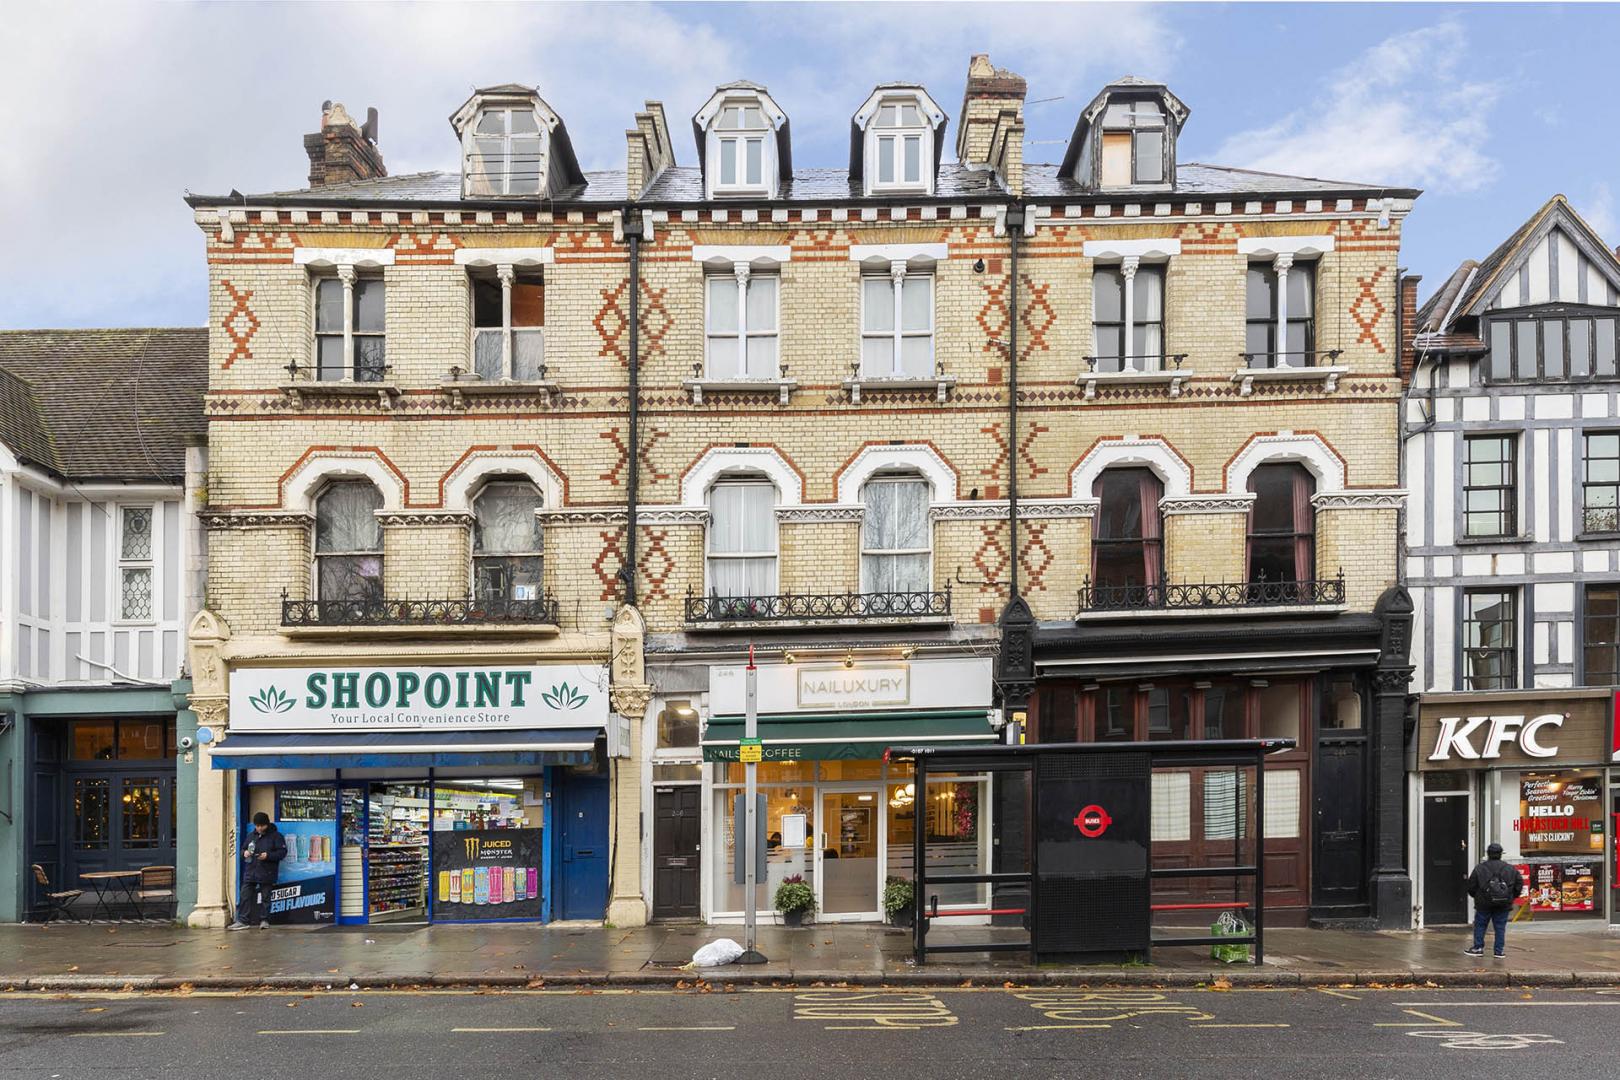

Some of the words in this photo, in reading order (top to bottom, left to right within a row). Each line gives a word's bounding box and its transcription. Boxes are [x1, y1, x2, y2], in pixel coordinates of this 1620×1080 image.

[305, 671, 532, 709] SHOPOINT
[804, 679, 902, 694] NAILUXURY
[331, 713, 359, 723] Your
[362, 713, 394, 723] Local
[1428, 714, 1565, 761] KFC
[709, 749, 740, 759] NAILS
[1527, 794, 1557, 802] Greetings
[1529, 804, 1574, 816] HELLO
[1513, 816, 1568, 832] HAVERSTOCK
[1571, 815, 1590, 830] HILL
[1529, 832, 1548, 842] WHAT'S
[482, 840, 512, 849] JUICED
[277, 887, 298, 899] SUGAR
[270, 900, 286, 914] ESH
[286, 892, 326, 911] FLAVOURS
